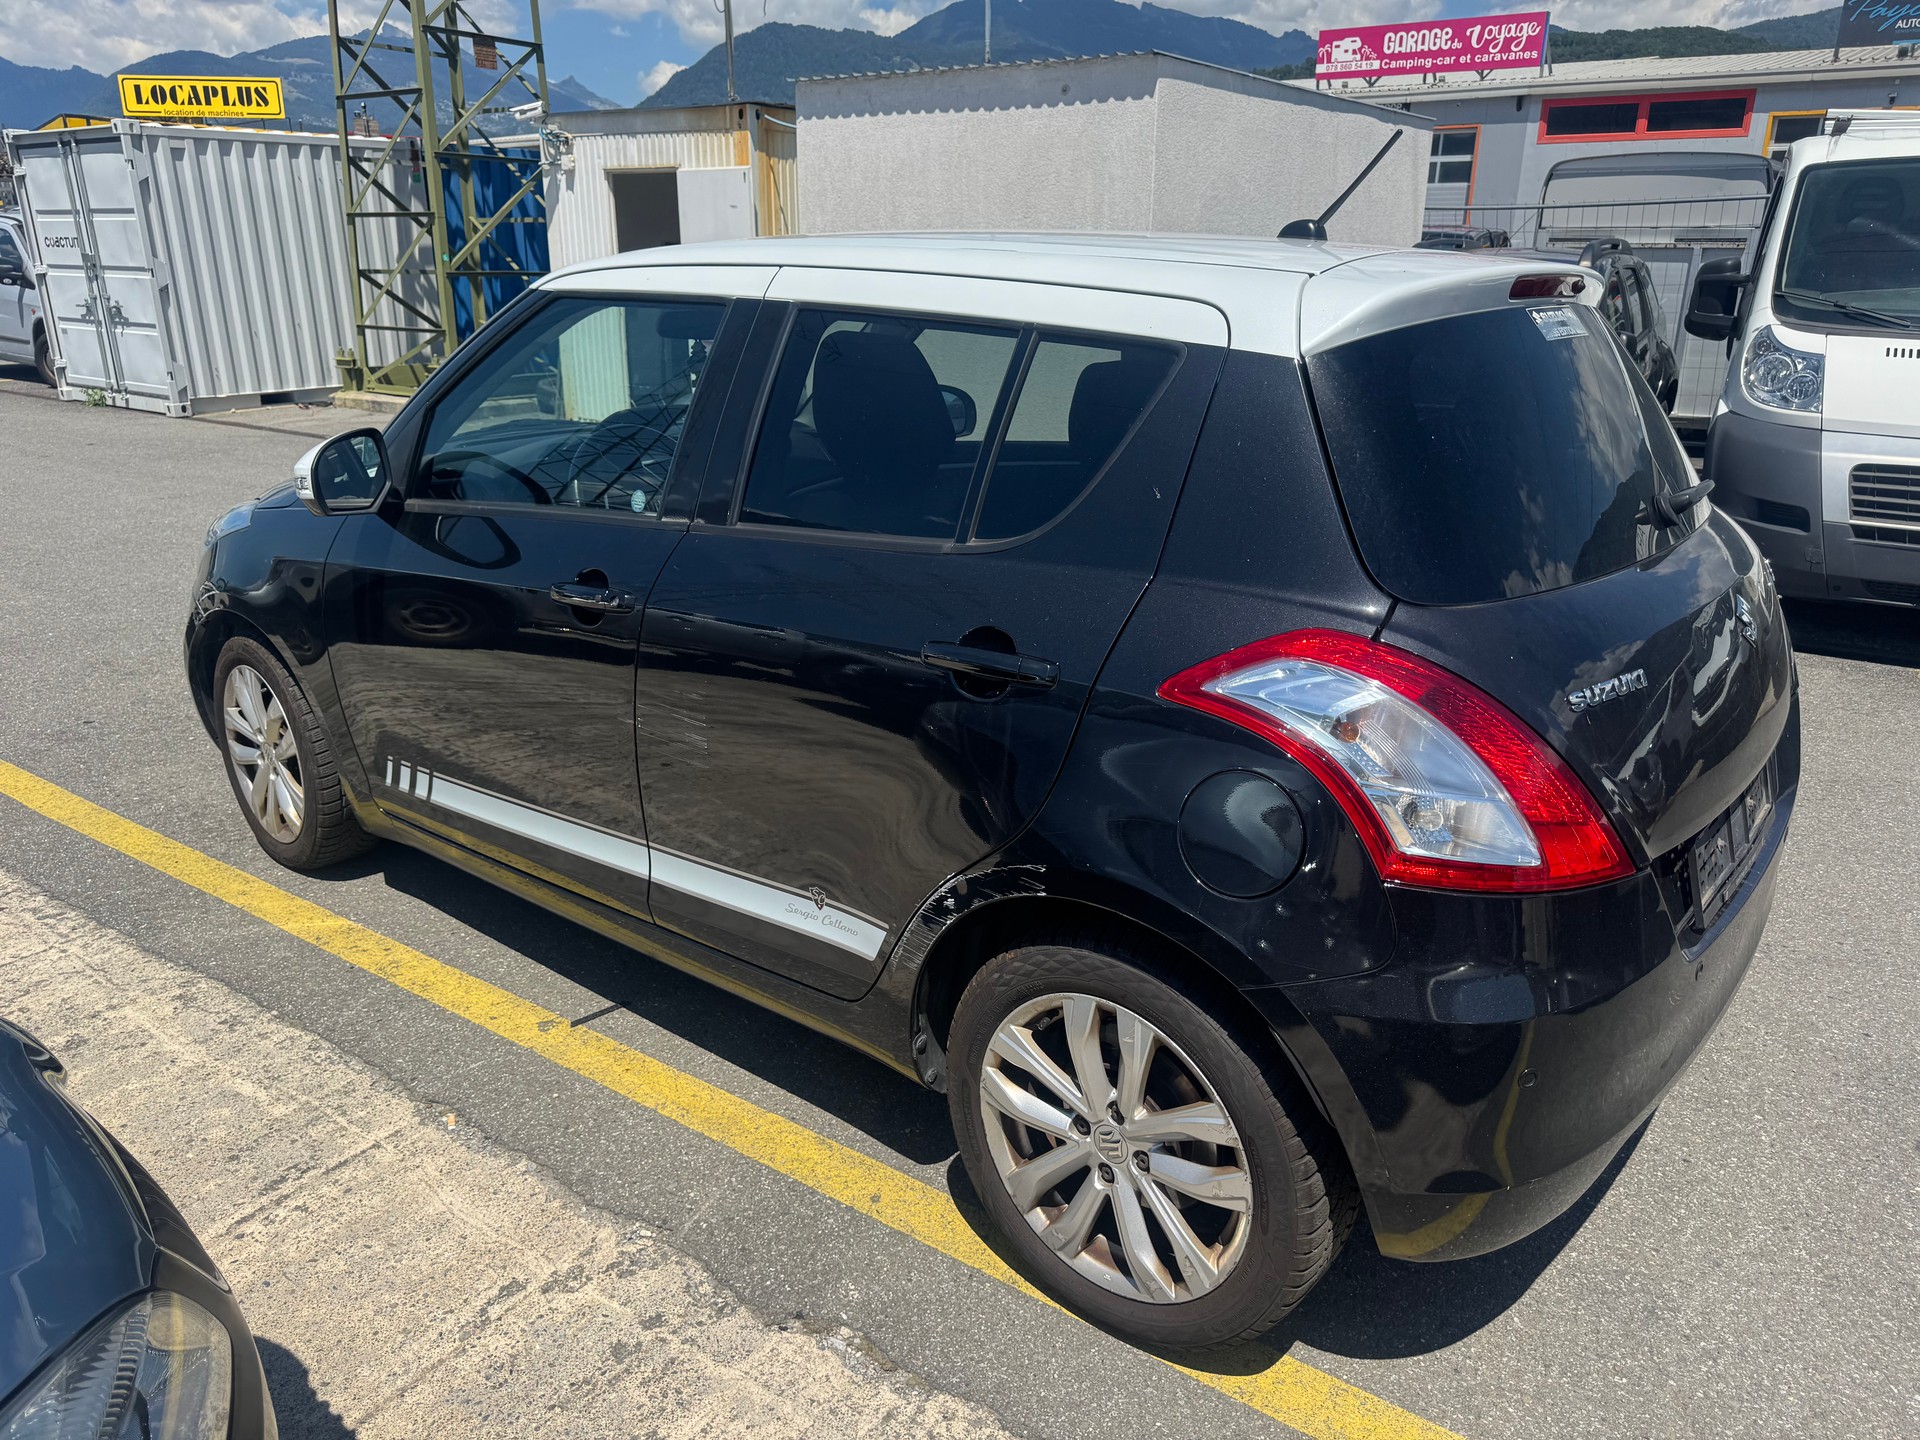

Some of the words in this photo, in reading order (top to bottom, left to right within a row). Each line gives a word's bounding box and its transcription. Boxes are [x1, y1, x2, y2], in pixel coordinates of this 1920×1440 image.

[1451, 38, 1463, 49] du
[1381, 55, 1456, 70] Camping-car
[1459, 53, 1471, 63] et
[1474, 50, 1538, 62] caravanes
[133, 84, 270, 108] LOCAPLUS
[163, 108, 194, 116] location
[195, 109, 206, 117] de
[207, 109, 245, 118] machines
[1567, 668, 1648, 712] SUZUKI
[785, 902, 819, 921] Sergio
[821, 914, 859, 937] Cellano
